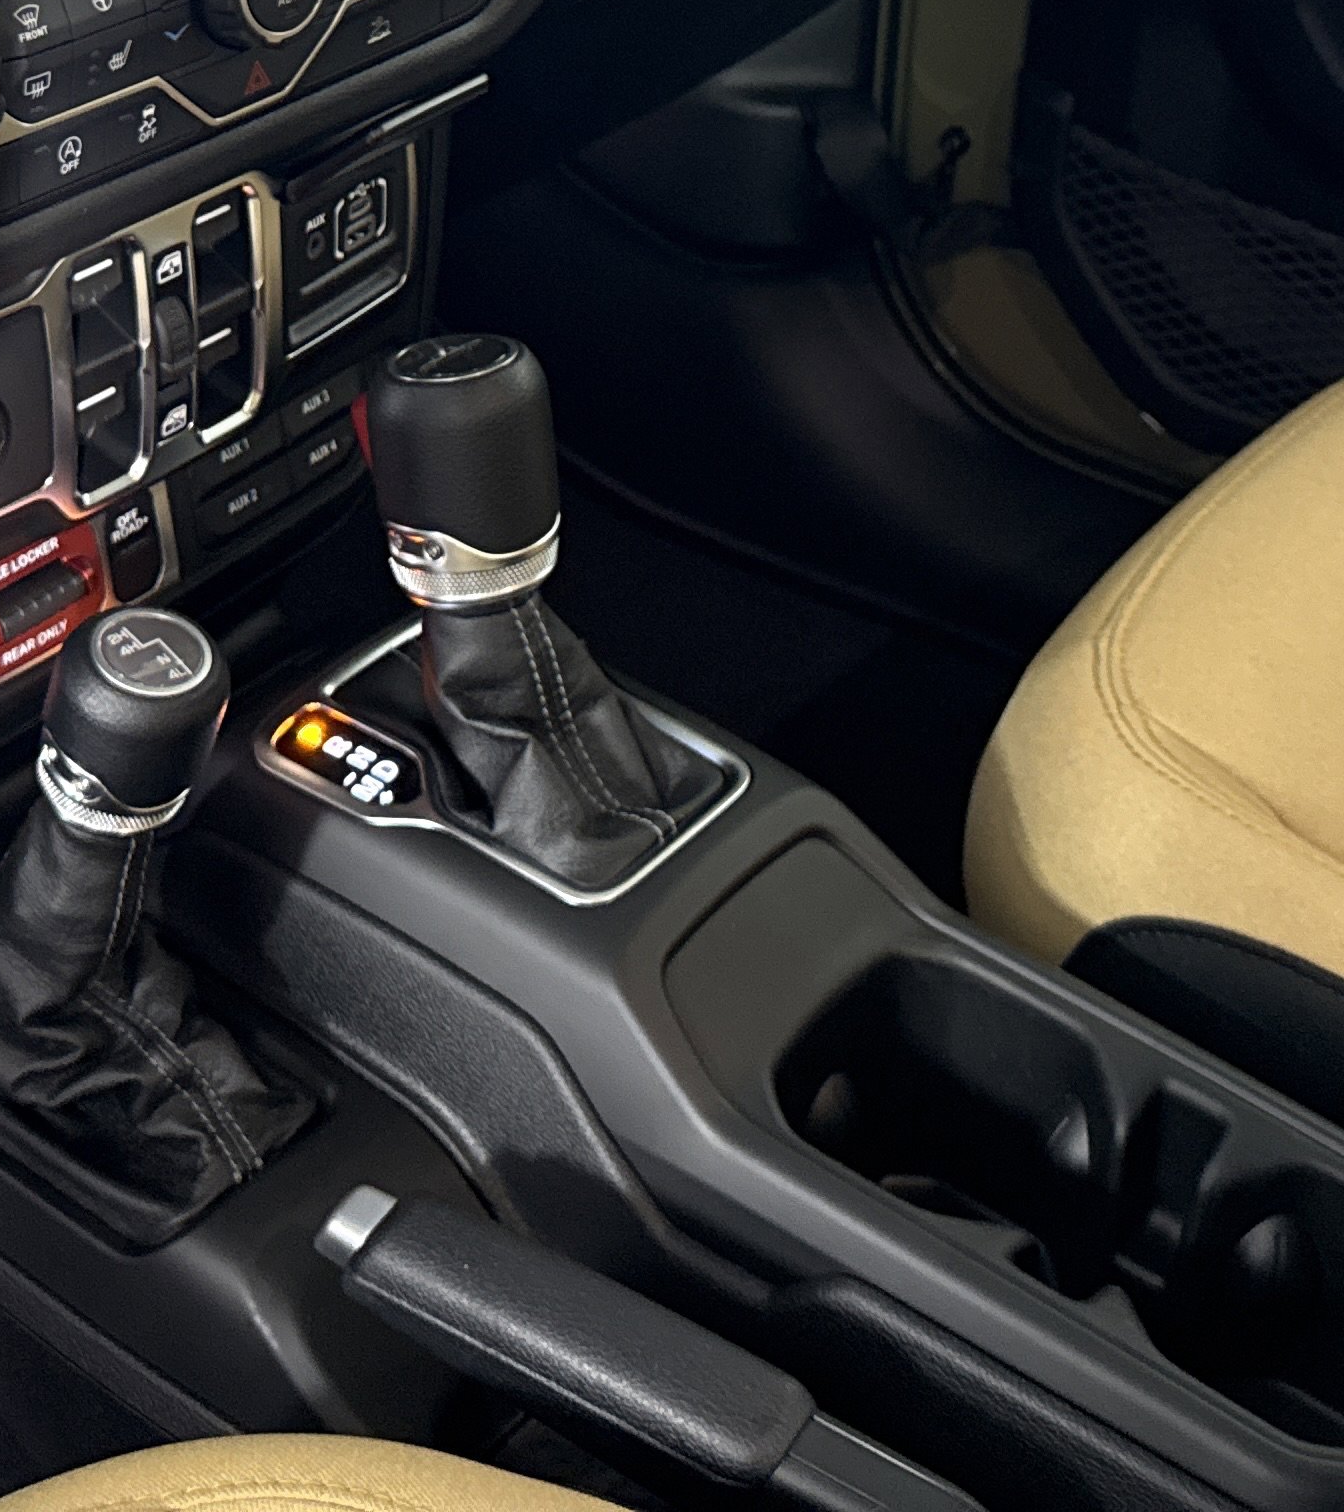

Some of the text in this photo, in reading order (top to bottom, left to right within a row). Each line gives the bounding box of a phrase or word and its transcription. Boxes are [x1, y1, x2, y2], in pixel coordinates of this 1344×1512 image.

[18, 25, 49, 43] FRONT
[138, 127, 157, 143] OFF
[60, 158, 80, 175] OFF
[305, 213, 326, 233] AUX
[302, 395, 323, 414] AUX
[220, 443, 243, 463] AUX
[309, 444, 332, 465] AUX
[227, 493, 251, 514] AUX
[115, 507, 139, 529] OFF
[11, 536, 60, 572] LOCKER
[0, 618, 68, 666] REAR ONLY
[120, 643, 142, 657] 4H
[156, 653, 172, 665] N
[167, 668, 187, 680] 4L
[371, 759, 399, 783] D
